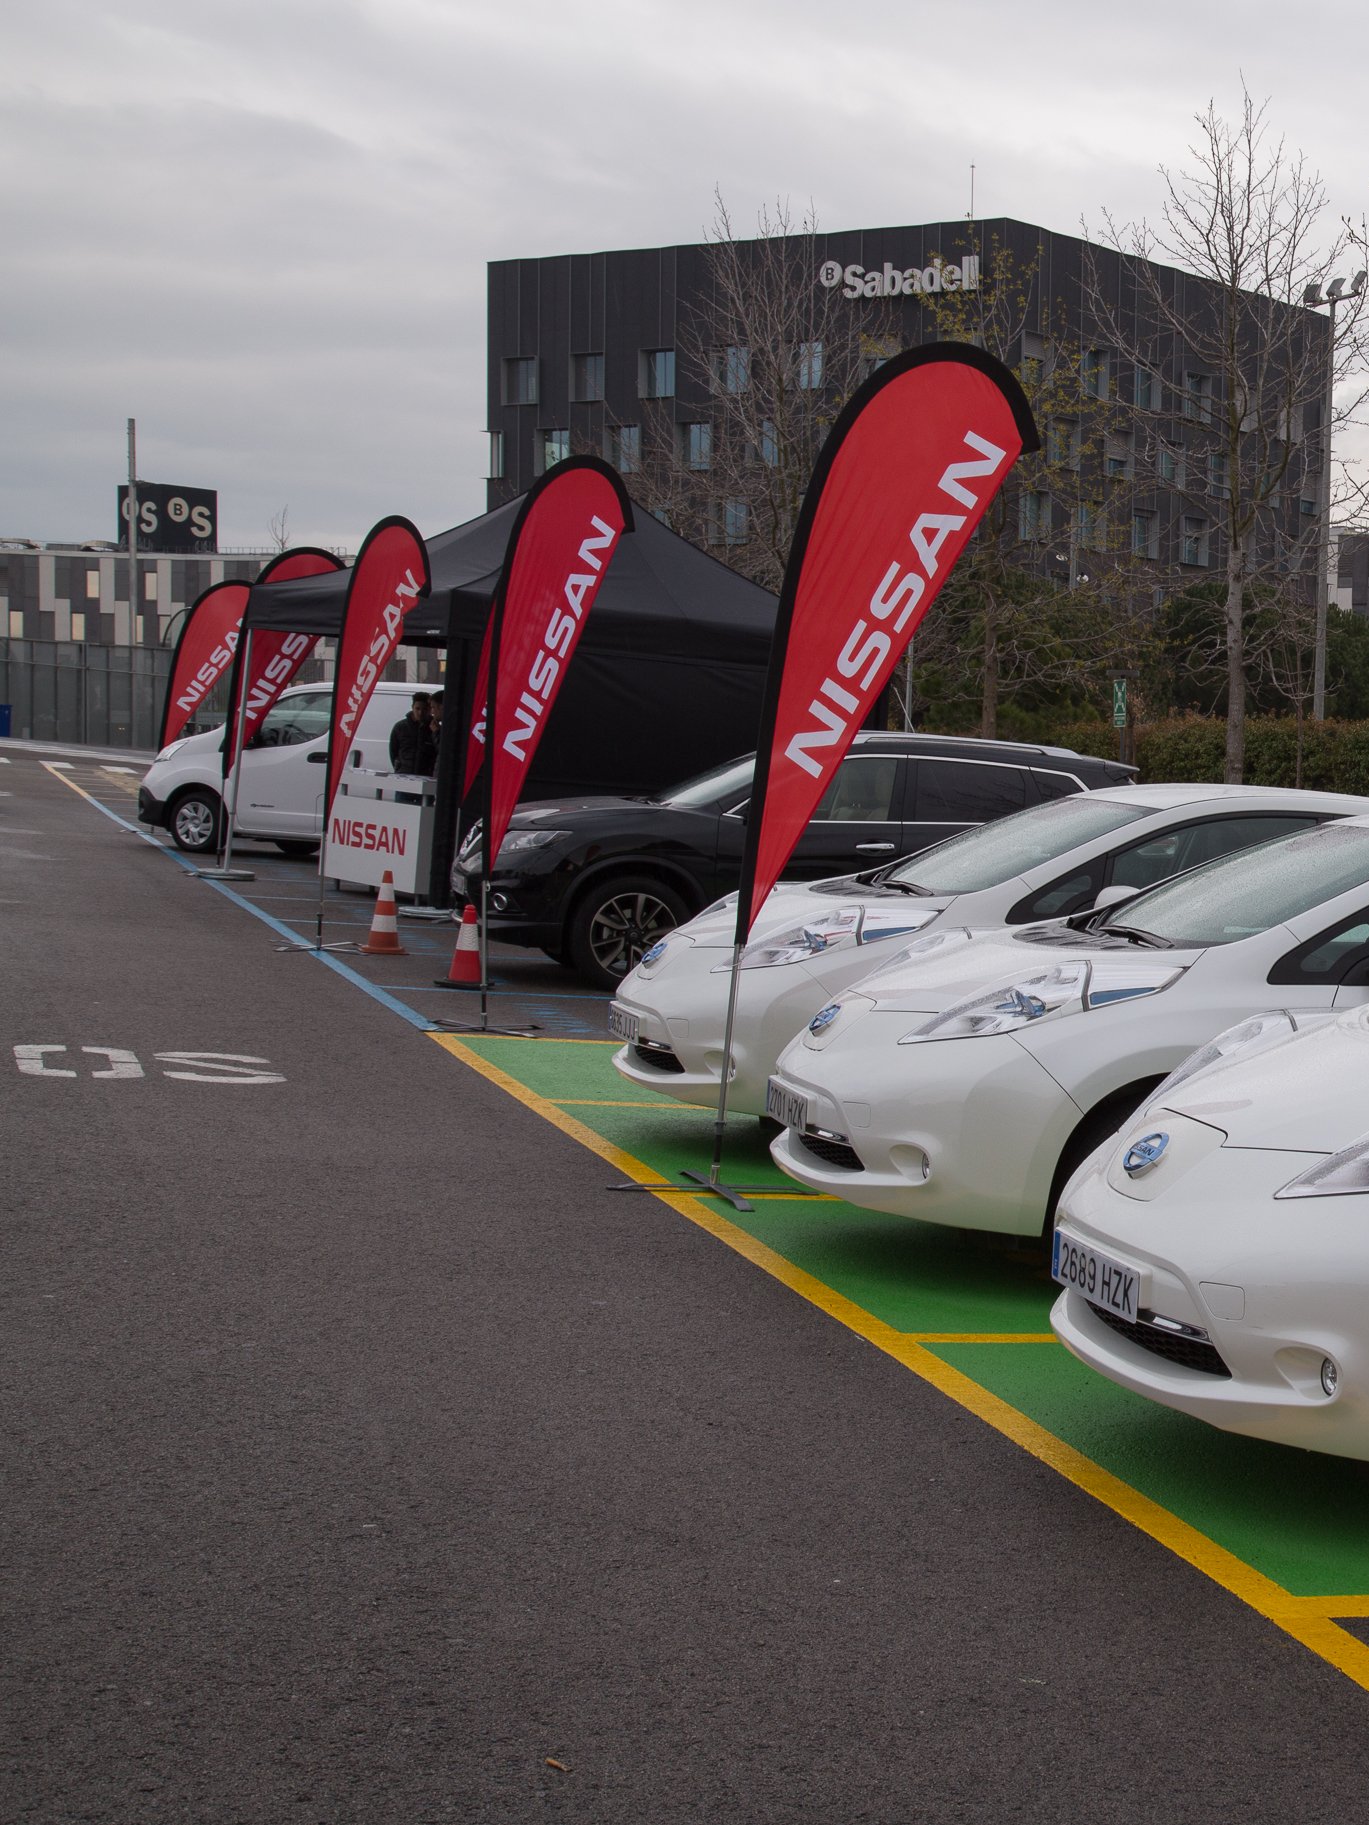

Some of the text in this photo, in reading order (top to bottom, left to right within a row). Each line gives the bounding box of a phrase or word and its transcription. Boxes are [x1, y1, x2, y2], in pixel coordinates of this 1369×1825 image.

[842, 255, 979, 298] Sabadell
[784, 430, 1007, 779] NISSAN
[502, 515, 616, 762] NISSAN
[332, 818, 406, 856] NISSAN
[769, 1087, 804, 1130] 2701 HZK
[1060, 1242, 1134, 1315] 2689 HZK
